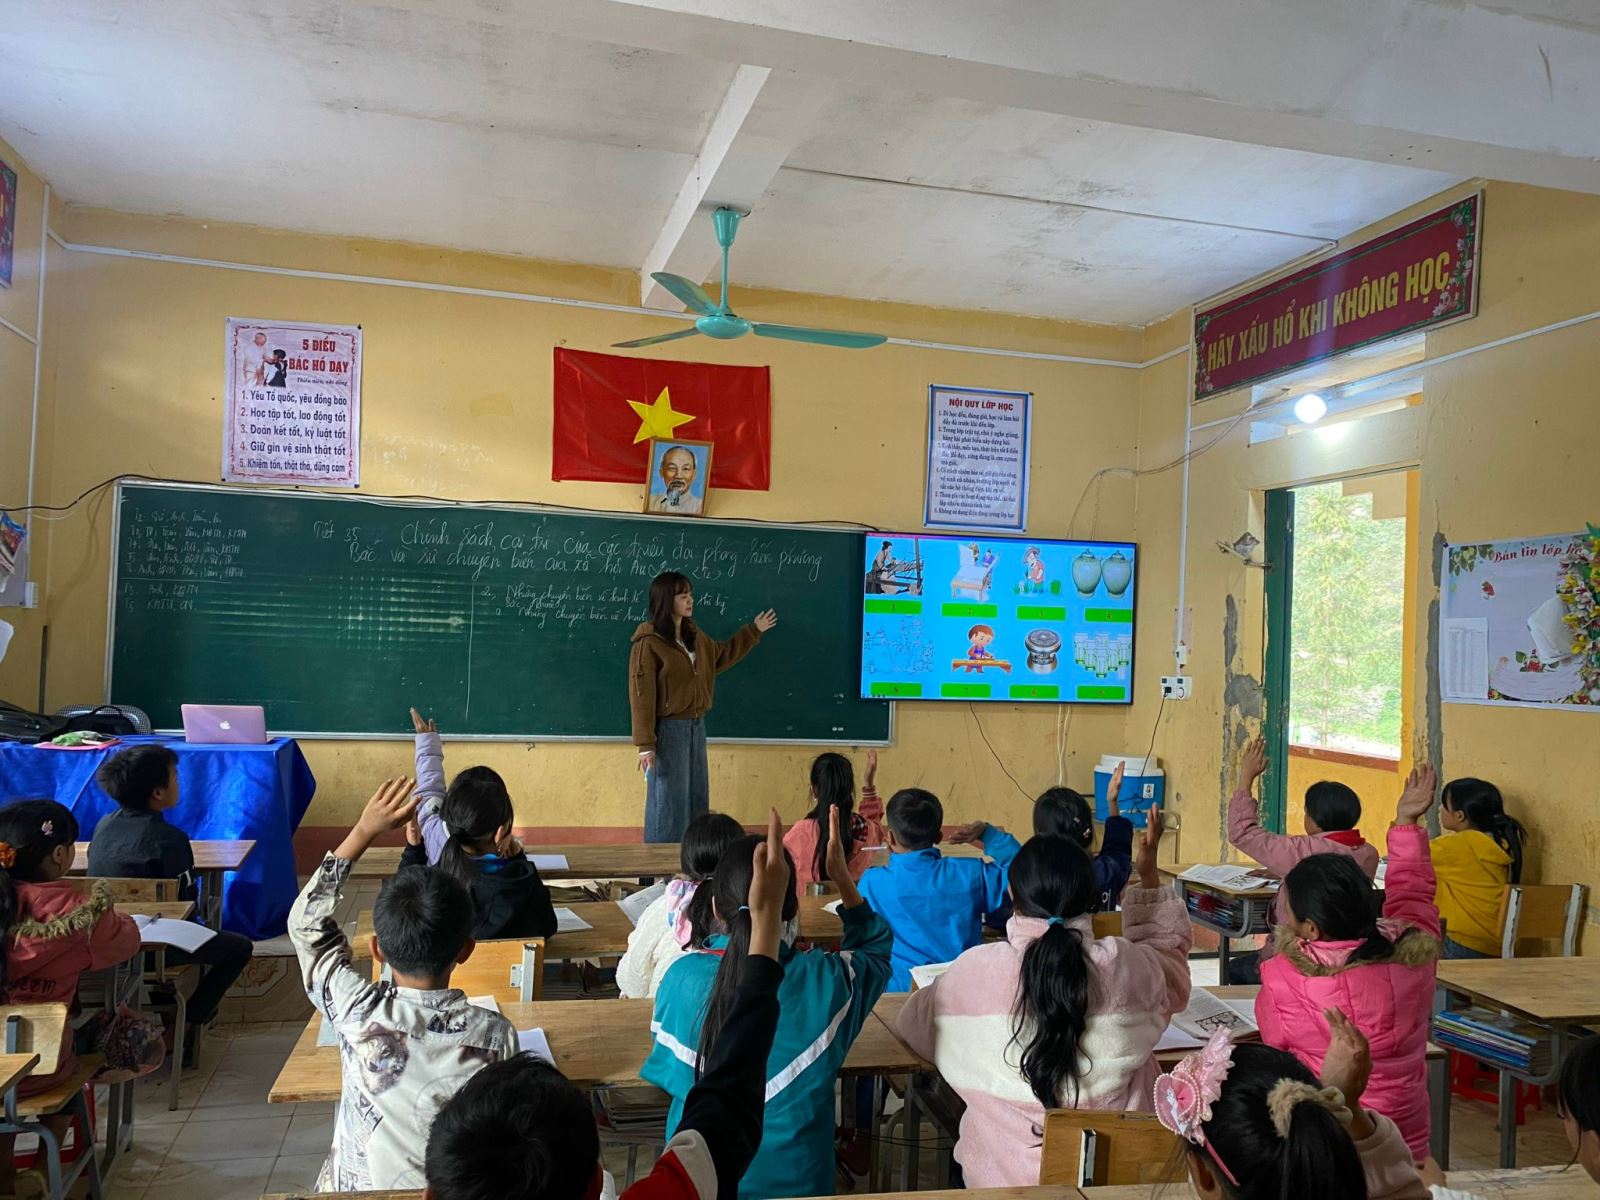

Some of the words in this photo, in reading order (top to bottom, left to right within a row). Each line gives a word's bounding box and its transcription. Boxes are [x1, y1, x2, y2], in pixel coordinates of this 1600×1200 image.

[1208, 334, 1235, 373] HÃY
[1238, 315, 1268, 361] XẤU
[1272, 299, 1295, 349] HỔ
[1299, 298, 1328, 340] KHI
[1333, 272, 1399, 328] KHÔNG
[1404, 252, 1450, 304] HỌC
[302, 339, 309, 351] 5
[289, 355, 309, 371] BÁC
[329, 360, 349, 376] DẠY
[242, 390, 248, 400] 1.
[251, 390, 265, 401] Yêu
[278, 390, 297, 404] quốc,
[300, 393, 312, 405] yêu
[949, 398, 962, 408] NỘI
[965, 400, 980, 408] QUY
[982, 400, 996, 410] LỚP
[998, 402, 1014, 412] HỌC
[241, 407, 248, 417] 2.
[251, 407, 266, 420] Học
[268, 408, 281, 421] tập
[283, 407, 297, 420] tốt,
[299, 410, 311, 420] lao
[314, 410, 333, 424] động
[335, 410, 346, 422] tốt
[240, 424, 248, 434] 3.
[274, 424, 287, 436] kết
[289, 424, 302, 438] tốt,
[317, 427, 332, 441] luật
[335, 426, 346, 439] tốt
[240, 441, 248, 451] 4.
[251, 441, 266, 452] Giữ
[283, 443, 293, 456] vệ
[295, 443, 312, 454] sinh
[315, 444, 332, 457] thật
[335, 444, 346, 456] tốt
[247, 458, 268, 469] Khiêm
[285, 459, 298, 473] thật
[314, 461, 330, 474] dũng
[344, 527, 361, 542] 35
[401, 518, 450, 545] Chính
[1521, 546, 1538, 557] tin
[1542, 543, 1563, 557] lớp
